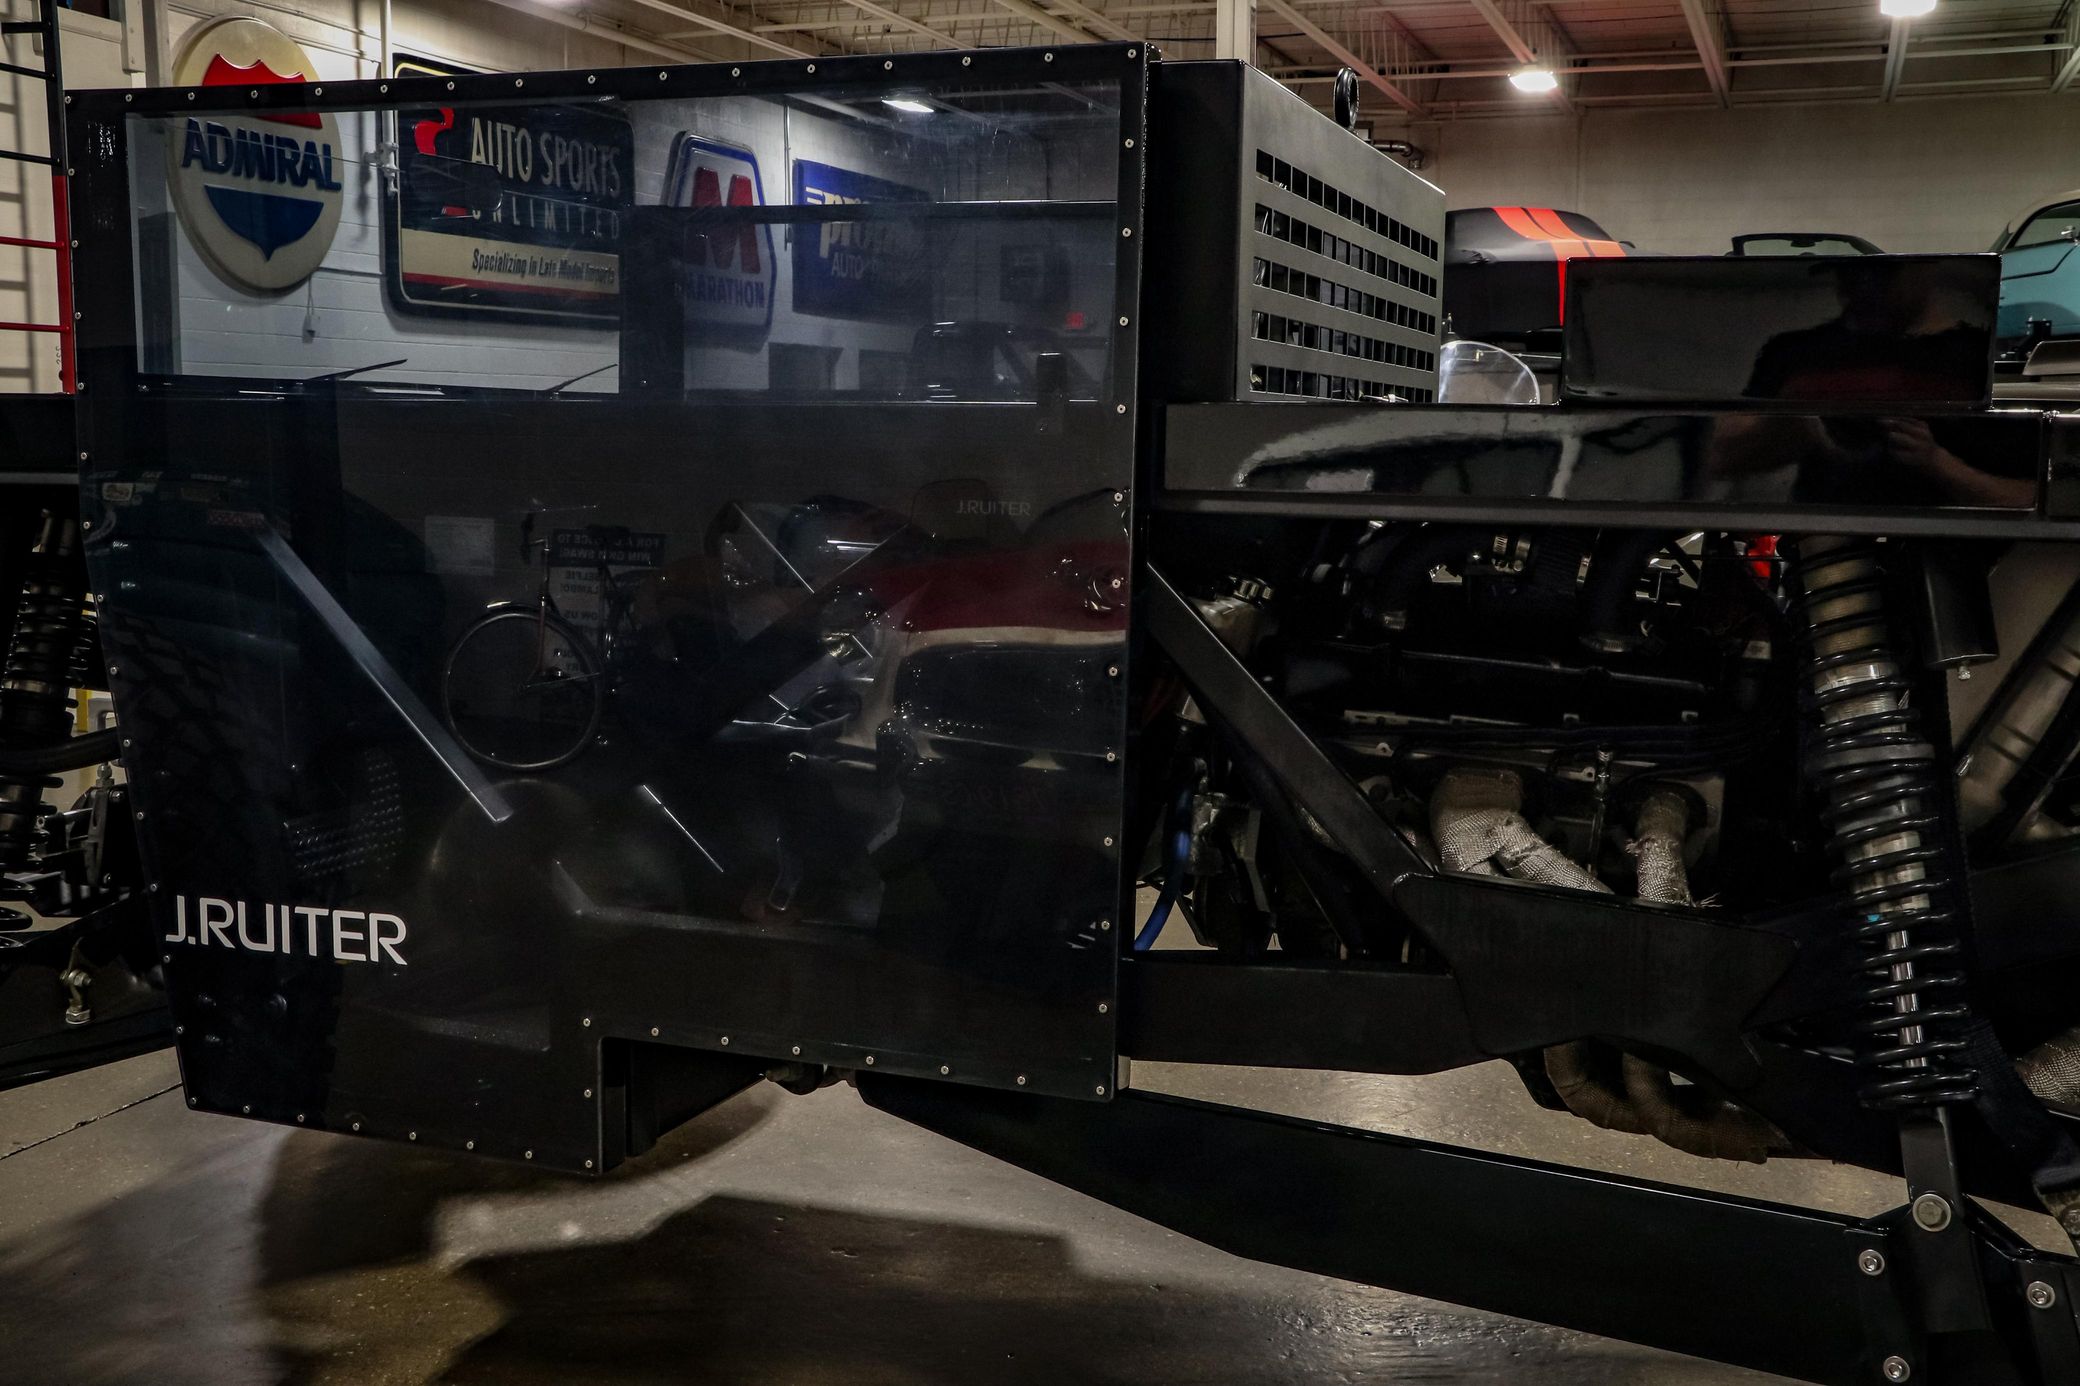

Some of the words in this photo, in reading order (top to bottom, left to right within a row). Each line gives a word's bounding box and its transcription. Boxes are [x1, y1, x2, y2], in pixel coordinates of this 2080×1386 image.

[181, 116, 343, 193] ADMIRAL
[470, 117, 533, 183] AUTO
[540, 131, 621, 199] SPORTS
[472, 249, 527, 279] Specializing
[539, 255, 558, 278] Late
[956, 500, 1031, 516] J.RUITER
[165, 894, 408, 966] J.RUITER
